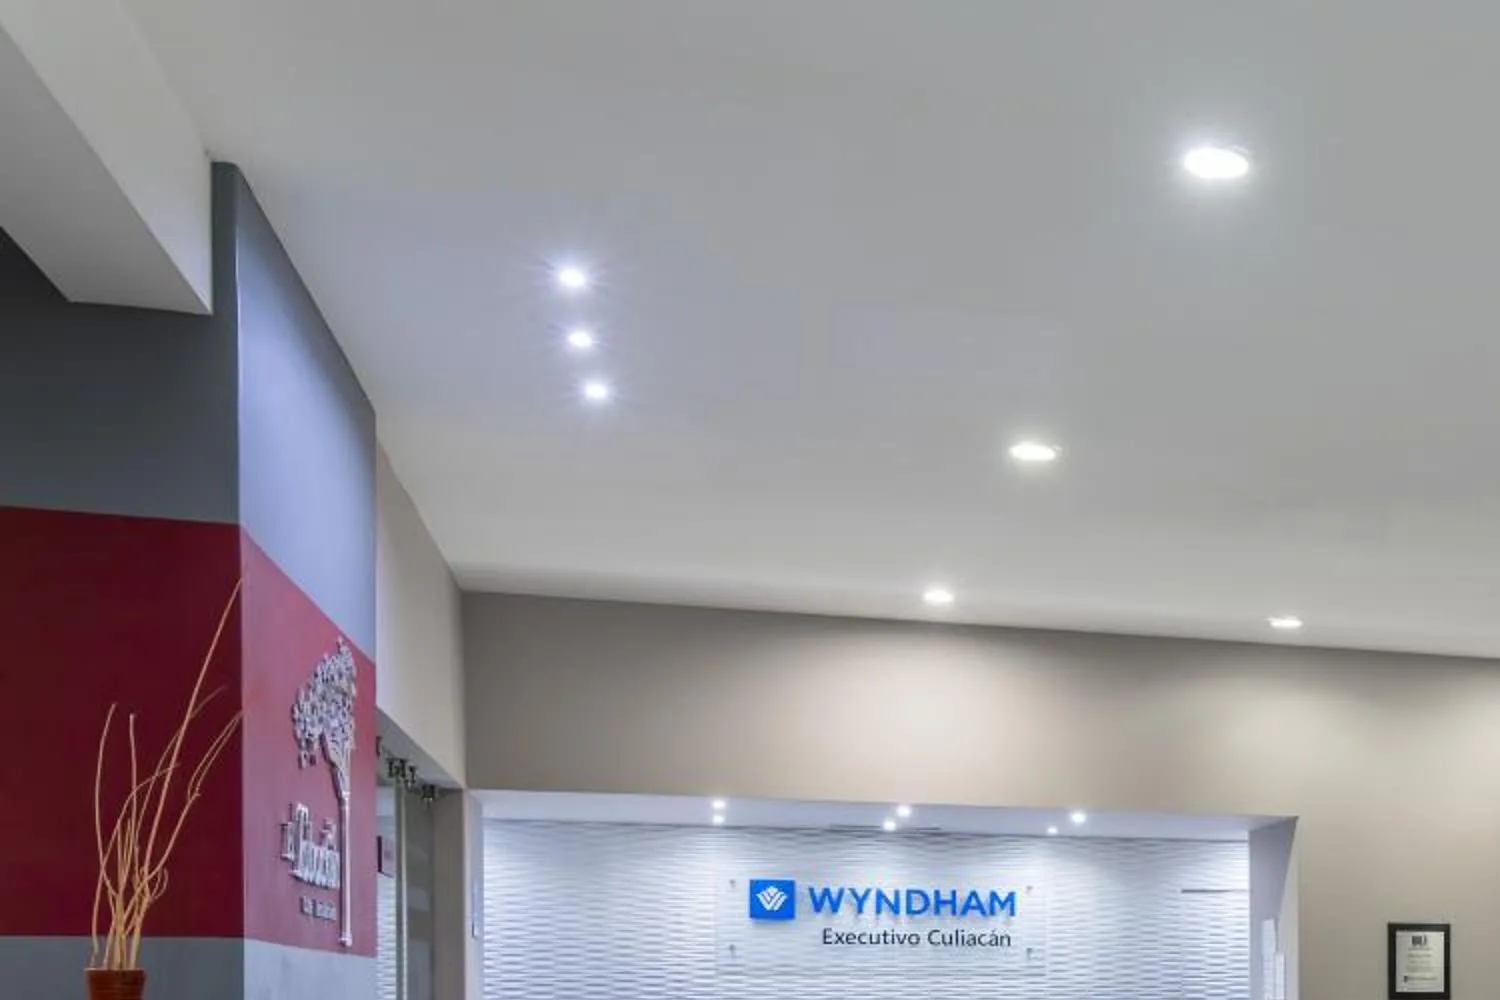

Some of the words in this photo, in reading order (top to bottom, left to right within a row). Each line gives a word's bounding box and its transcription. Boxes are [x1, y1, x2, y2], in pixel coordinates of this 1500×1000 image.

[808, 886, 1016, 917] WYNDHAM
[823, 928, 920, 946] Executivo
[927, 928, 1012, 947] Culiacán
